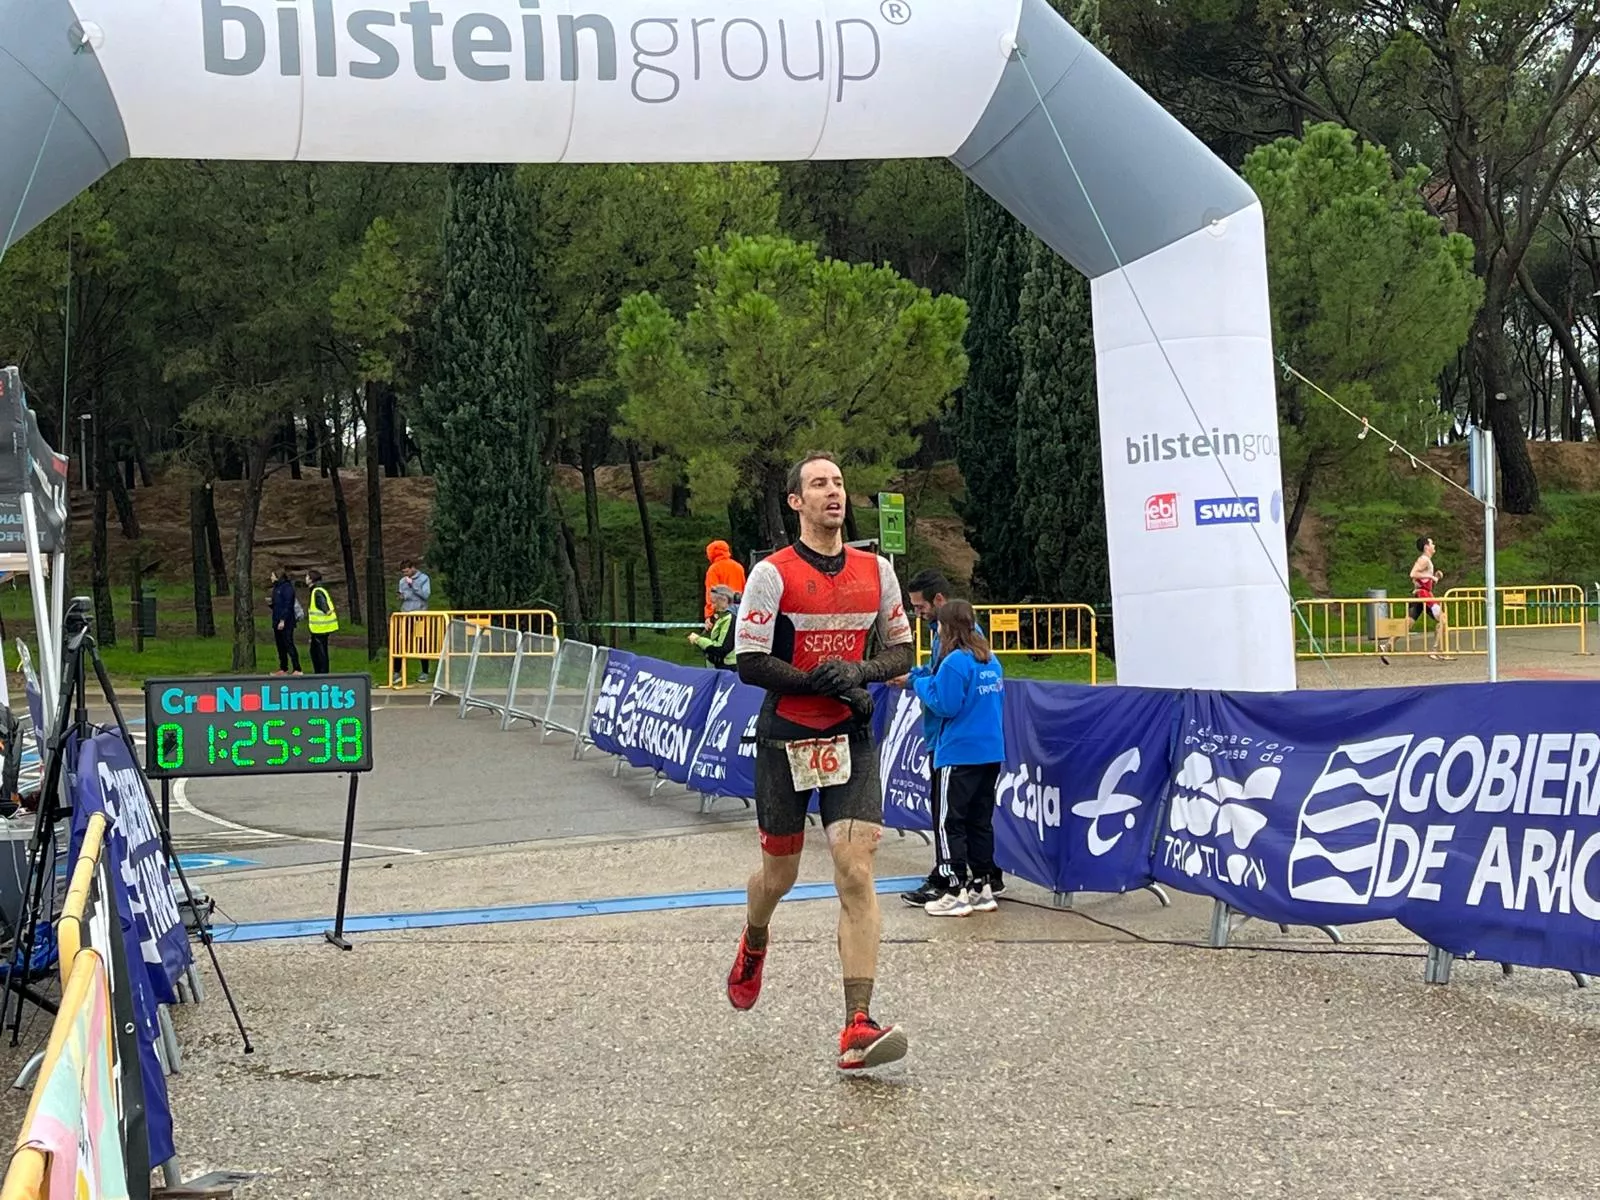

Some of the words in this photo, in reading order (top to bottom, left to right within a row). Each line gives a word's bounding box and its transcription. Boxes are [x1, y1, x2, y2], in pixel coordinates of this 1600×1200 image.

[1199, 502, 1257, 520] SWAG
[1260, 751, 1284, 764] de
[1399, 732, 1600, 816] GOBIER
[1374, 823, 1456, 902] DE
